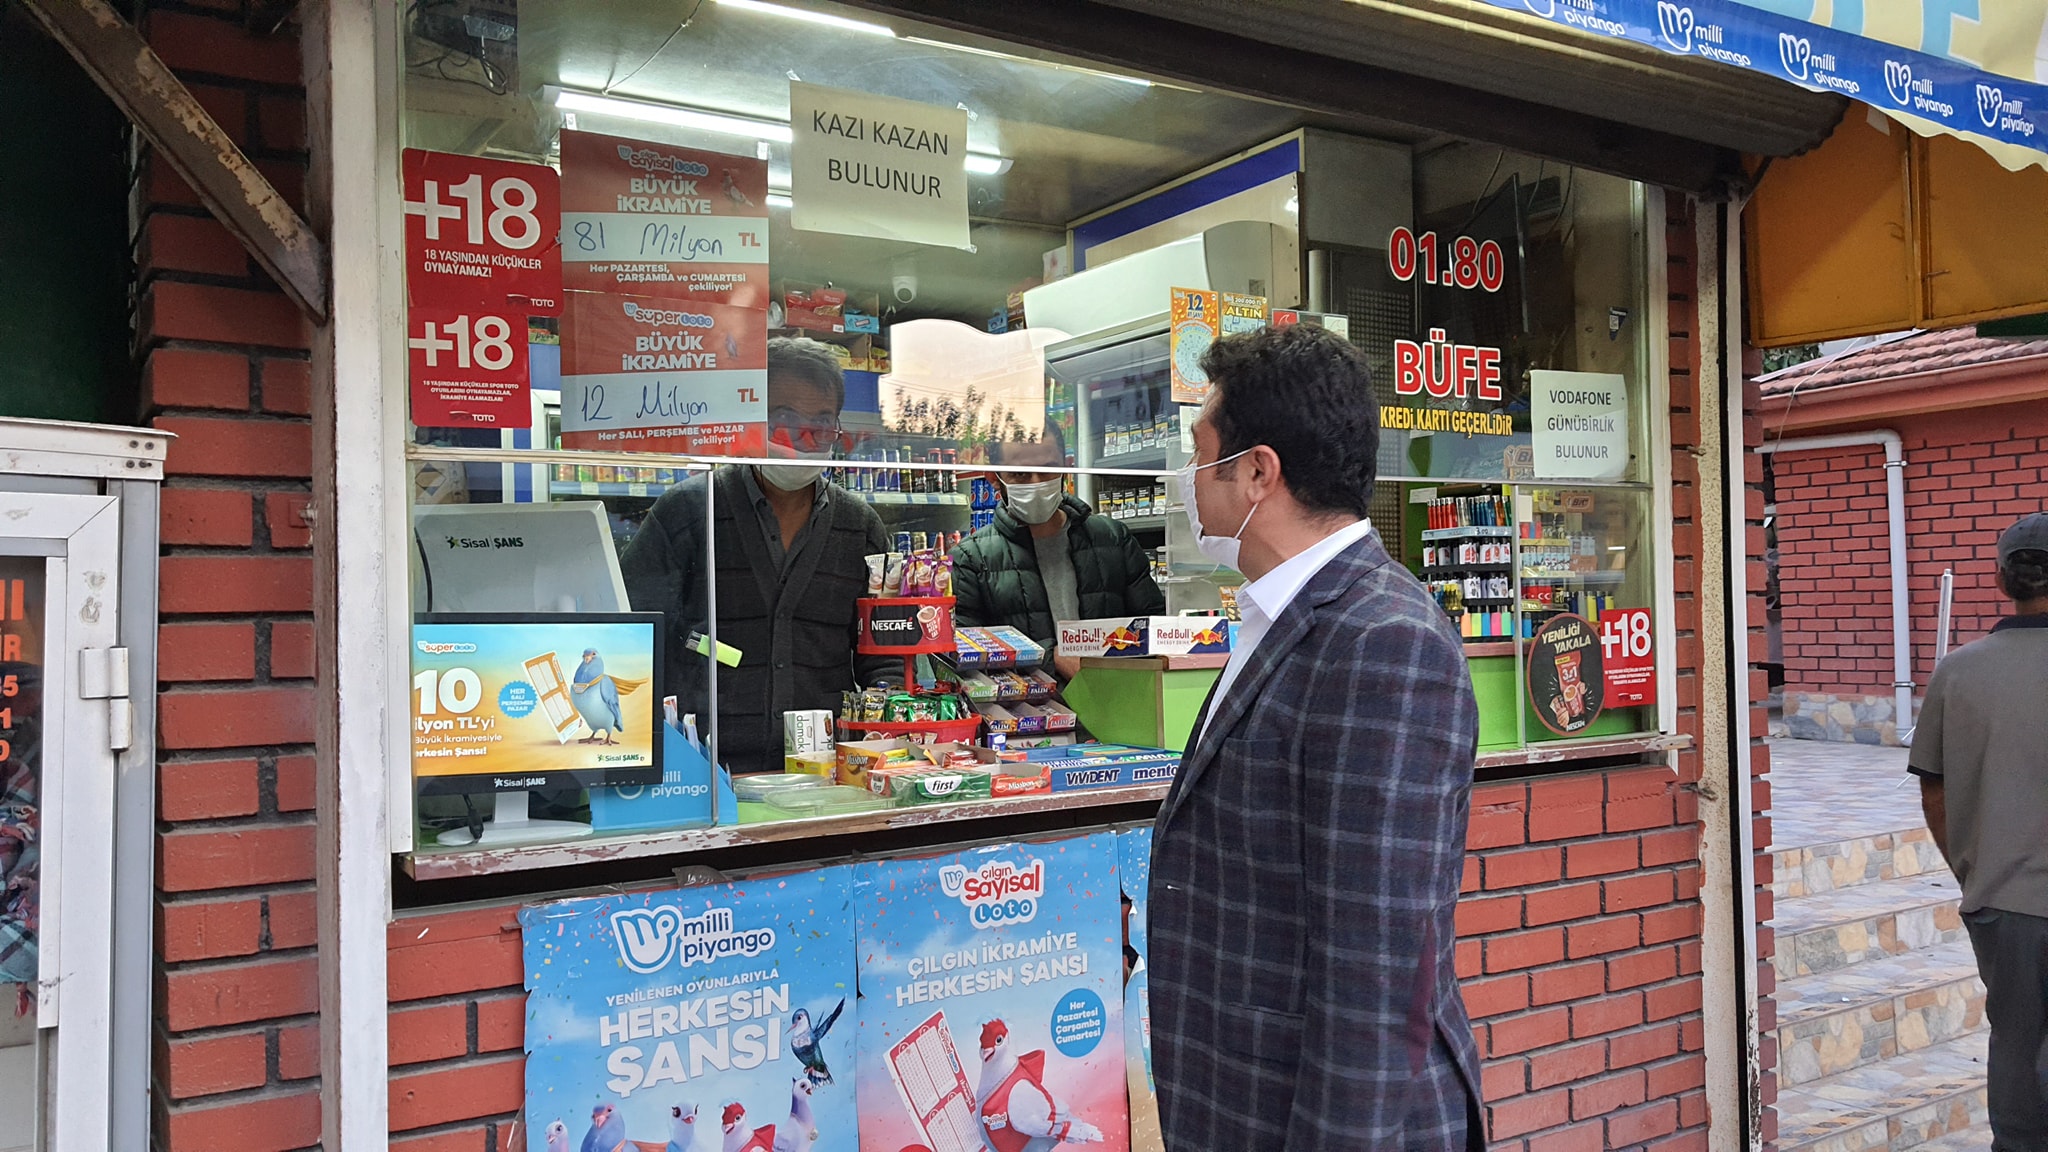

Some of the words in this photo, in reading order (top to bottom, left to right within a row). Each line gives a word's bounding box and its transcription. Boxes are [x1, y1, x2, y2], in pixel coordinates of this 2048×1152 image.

[1563, 10, 1625, 36] piyango
[1695, 24, 1723, 44] milli
[1698, 43, 1752, 66] piyango
[1811, 54, 1835, 72] milli
[1813, 70, 1860, 94] piyango
[1911, 78, 1934, 96] milli
[1914, 95, 1954, 118] piyango
[2002, 99, 2024, 115] milli
[813, 110, 864, 140] KAZI
[873, 121, 949, 156] KAZAN
[2001, 116, 2035, 137] piyango
[630, 174, 698, 195] BÜYÜK
[828, 158, 942, 199] BULUNUR
[404, 173, 541, 250] +18
[574, 221, 606, 251] 81
[640, 222, 723, 260] Milyon
[738, 232, 761, 247] TL
[424, 249, 437, 260] 18
[438, 250, 489, 265] YAŞINDAN
[491, 254, 542, 270] KÜÇÜKLER
[1389, 226, 1504, 292] 01.80
[424, 261, 492, 278] OYNAYAMAZ!
[589, 264, 610, 273] Her
[616, 272, 675, 283] ÇARŞAMBA
[676, 274, 689, 282] ve
[690, 273, 746, 282] CUMARTESİ
[688, 282, 733, 292] çekiliyor!
[530, 298, 554, 307] TOTO
[1186, 293, 1204, 311] 12
[635, 308, 681, 325] süper
[1226, 306, 1263, 318] ALTIN
[408, 315, 514, 370] +18
[636, 331, 703, 352] BÜYÜK
[1394, 328, 1502, 400] BÜFE
[582, 384, 612, 422] 12
[636, 381, 708, 424] Milyon
[737, 388, 760, 403] TL
[1549, 390, 1612, 406] VODAFONE
[472, 414, 495, 422] TOTO
[1380, 406, 1414, 429] KREDİ
[1416, 408, 1450, 431] KARTI
[1452, 411, 1513, 438] GEÇERLİDİR
[1547, 415, 1615, 433] GÜNÜBİRLİK
[598, 432, 617, 441] Her
[618, 430, 645, 440] SALI,
[646, 427, 699, 438] PERŞEMBE
[700, 427, 712, 435] ve
[713, 424, 745, 434] PAZAR
[692, 435, 736, 446] çekiliyor!
[1555, 445, 1609, 459] BULUNUR
[461, 538, 490, 548] Sisal
[494, 537, 524, 549] ŞANS
[872, 617, 913, 631] NESCAFÉ
[1157, 628, 1174, 638] Red
[1175, 628, 1190, 638] Bull
[1542, 621, 1581, 645] YENİLİĞİ
[1063, 629, 1081, 644] Red
[1082, 628, 1100, 643] Bull
[1601, 611, 1652, 658] +18
[425, 644, 453, 653] süper
[1554, 634, 1592, 654] YAKALA
[414, 667, 482, 715] 10
[415, 716, 454, 734] ilyon
[455, 747, 487, 757] Şansı!
[1133, 763, 1179, 780] mento
[504, 779, 522, 787] Sisal
[526, 778, 546, 787] ŞANS
[651, 784, 708, 798] piyango
[931, 780, 954, 791] first
[964, 864, 1041, 900] Sayısal
[981, 866, 1012, 880] çılgın
[976, 901, 1032, 922] loto
[683, 911, 731, 936] milli
[684, 931, 772, 962] piyango
[907, 949, 978, 979] ÇILGIN
[982, 930, 1078, 964] İKRAMİYE
[606, 984, 683, 1007] YENİLENEN
[686, 968, 780, 994] OYUNLARIYLA
[895, 966, 1014, 1008] HERKESİN
[1020, 952, 1088, 986] ŞANSI
[1069, 1001, 1086, 1010] Her
[600, 983, 790, 1047] HERKESİN
[1057, 1007, 1098, 1023] Pazartesi
[1056, 1018, 1100, 1034] Çarşamba
[1056, 1028, 1101, 1044] Cumartesi
[606, 1017, 782, 1098] ŞANSI
